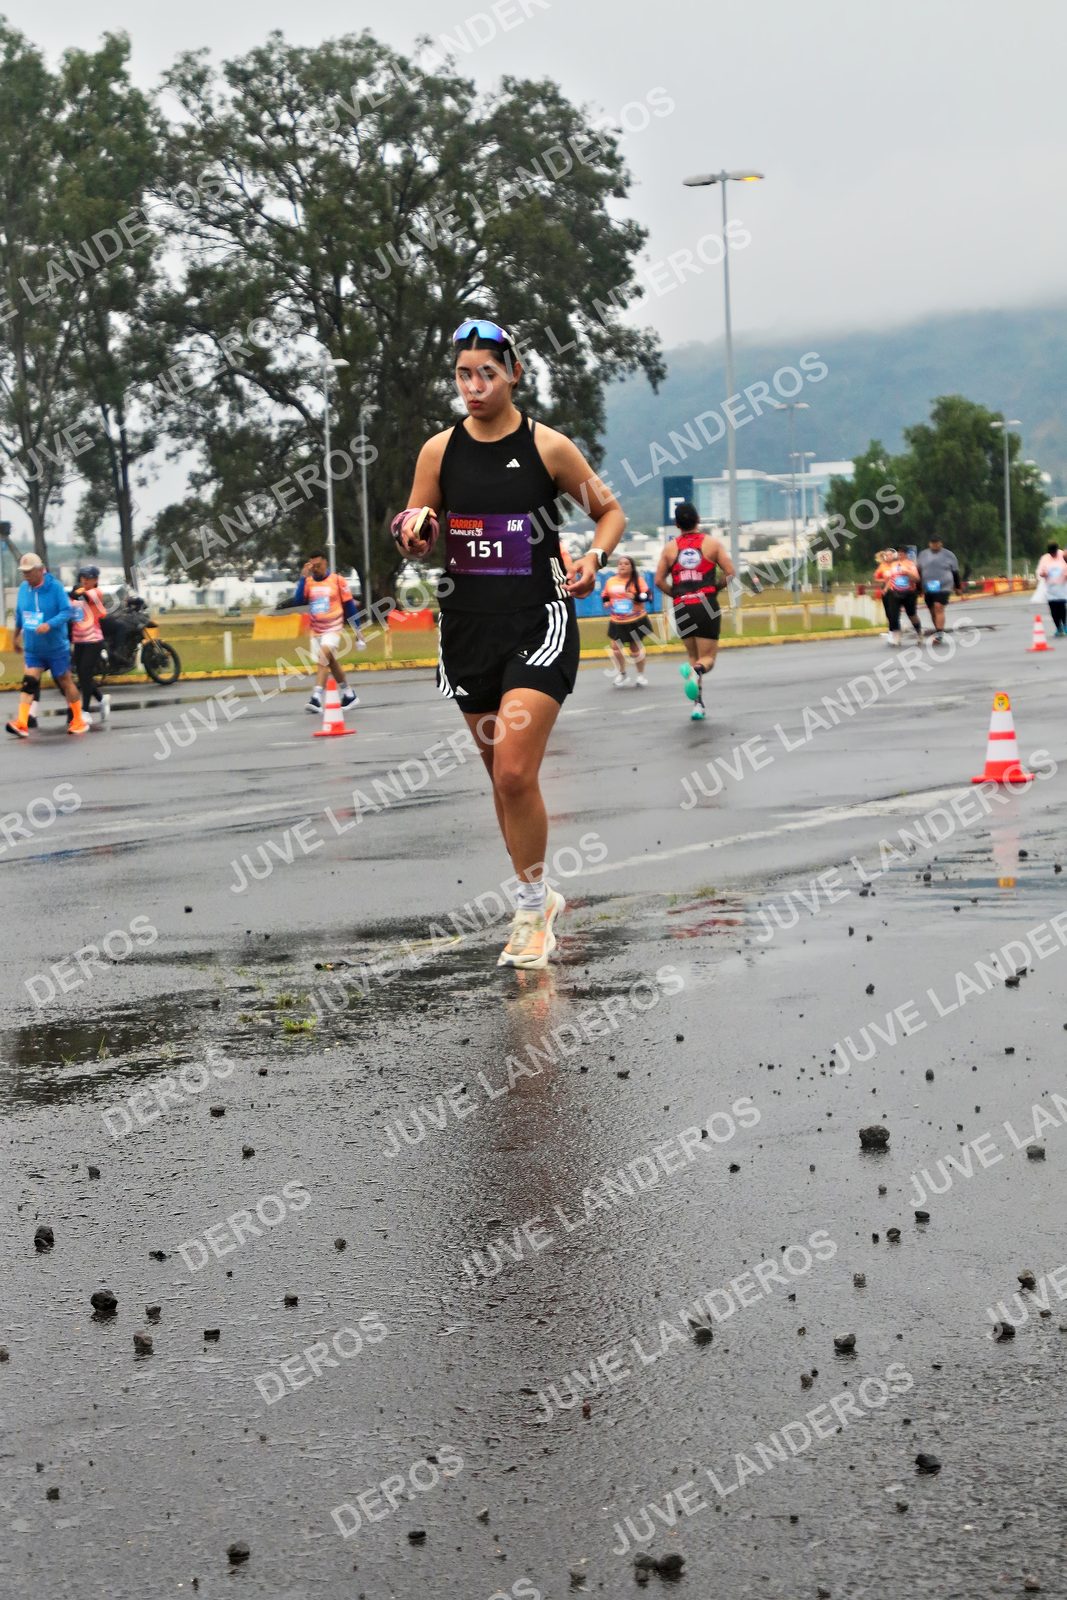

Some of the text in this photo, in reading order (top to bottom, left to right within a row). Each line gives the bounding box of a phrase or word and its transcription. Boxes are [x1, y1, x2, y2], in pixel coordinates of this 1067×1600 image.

[450, 518, 483, 529] CARRERA
[507, 519, 524, 532] 15K
[466, 540, 503, 558] 151
